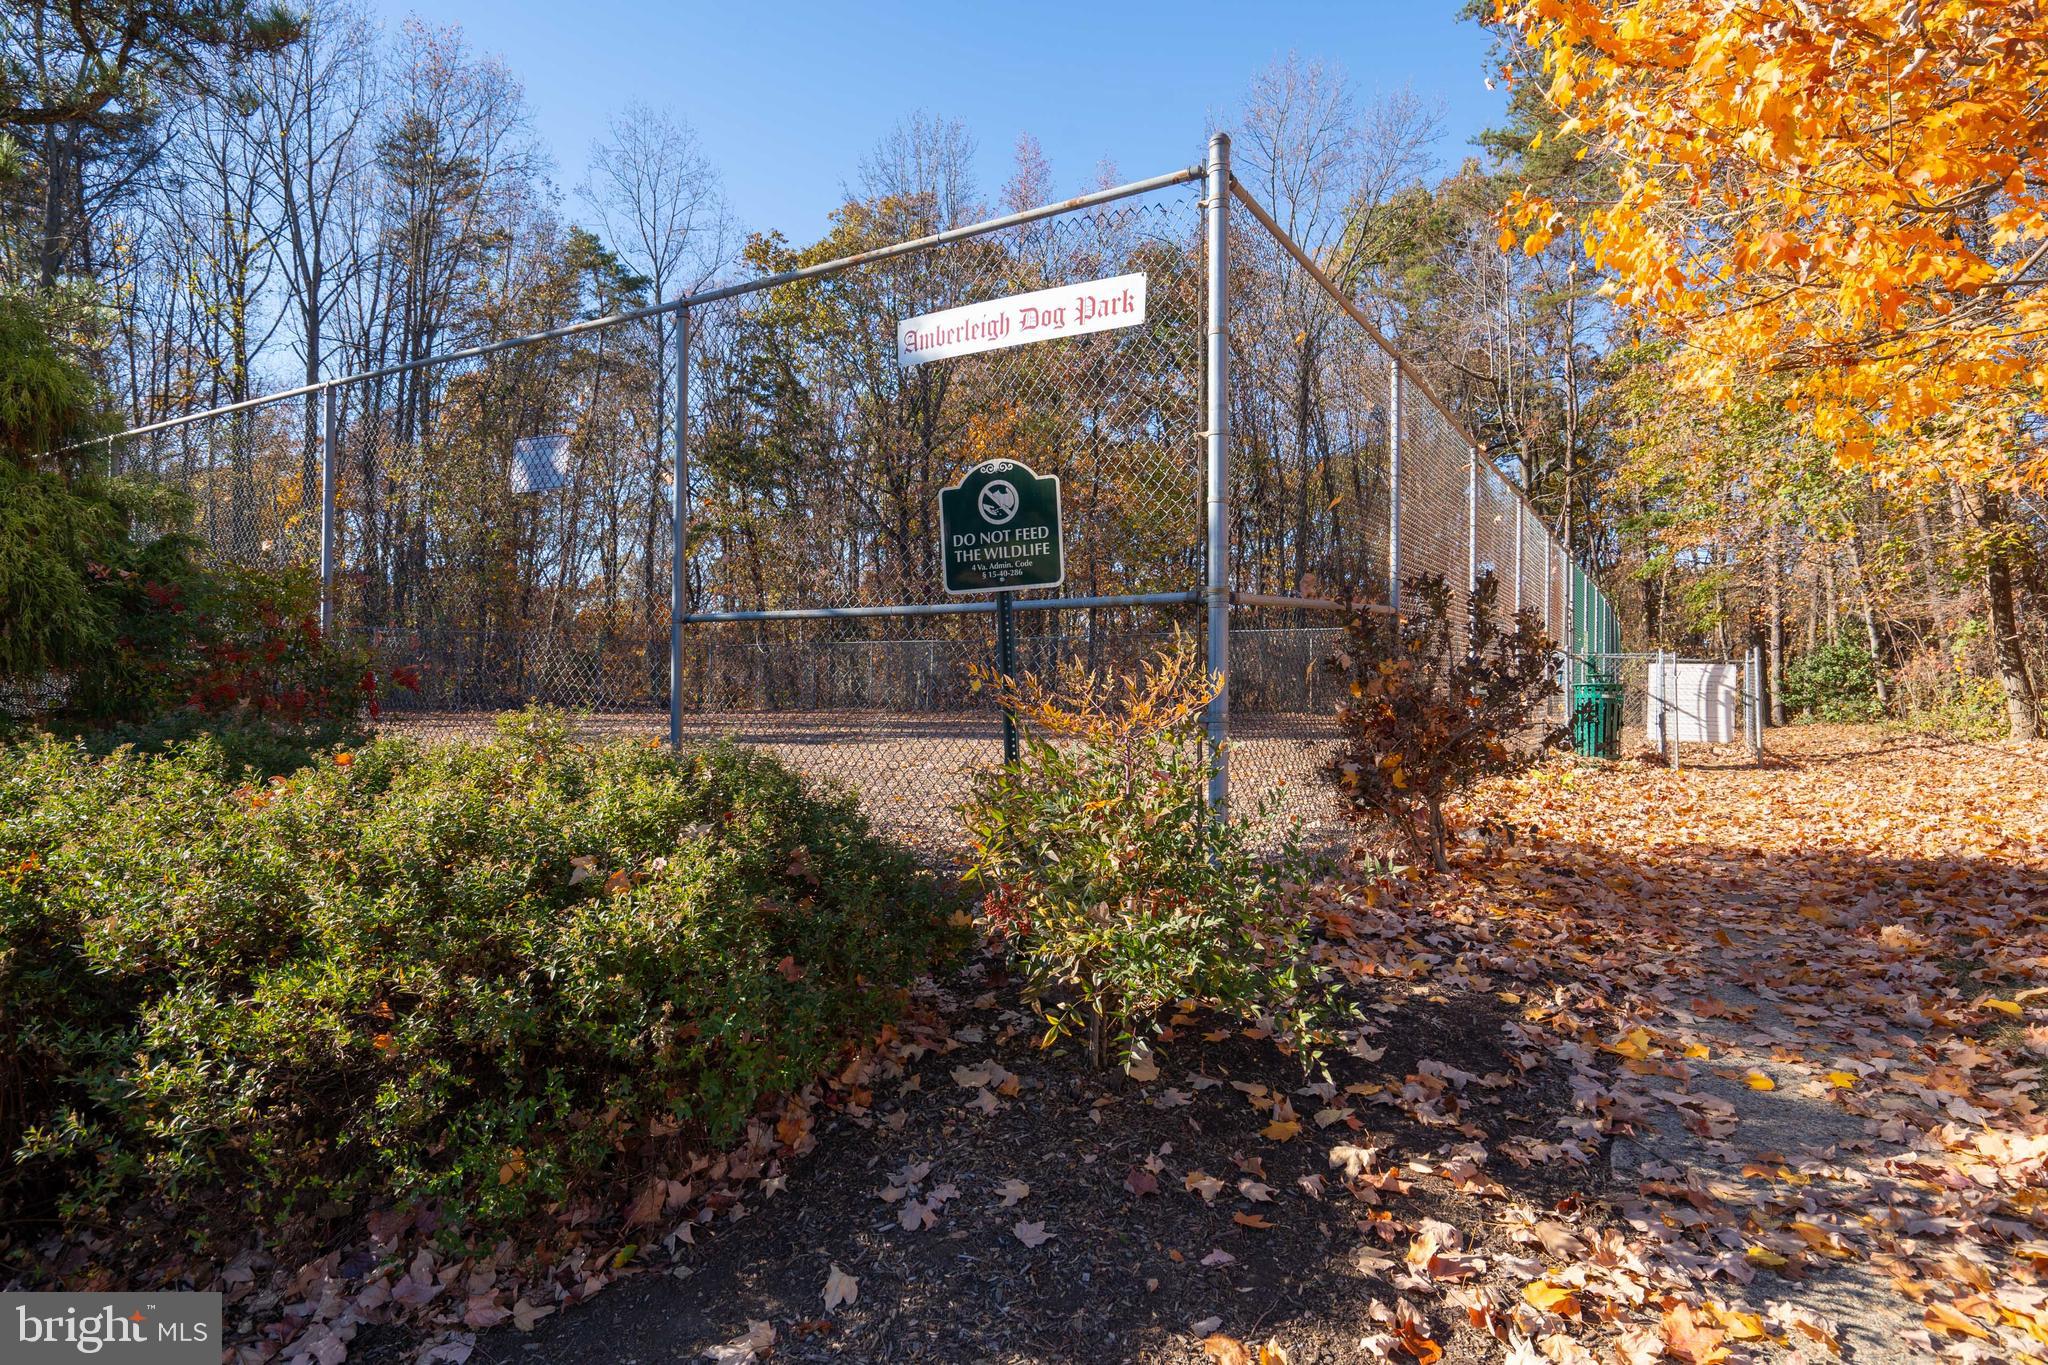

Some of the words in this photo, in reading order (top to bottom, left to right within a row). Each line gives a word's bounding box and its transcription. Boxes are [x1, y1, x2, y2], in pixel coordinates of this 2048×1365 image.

[904, 312, 1010, 354] Amberleigh
[1019, 307, 1066, 332] Dog
[1074, 288, 1135, 326] Park
[953, 533, 976, 547] DO
[980, 529, 1011, 545] NOT
[1015, 526, 1049, 541] FEED
[954, 548, 981, 563] THE
[984, 542, 1050, 560] WILDLIFE
[977, 563, 988, 571] Va.
[989, 560, 1014, 570] Admin.
[1015, 560, 1033, 568] Code
[988, 569, 1023, 579] 15-40-286
